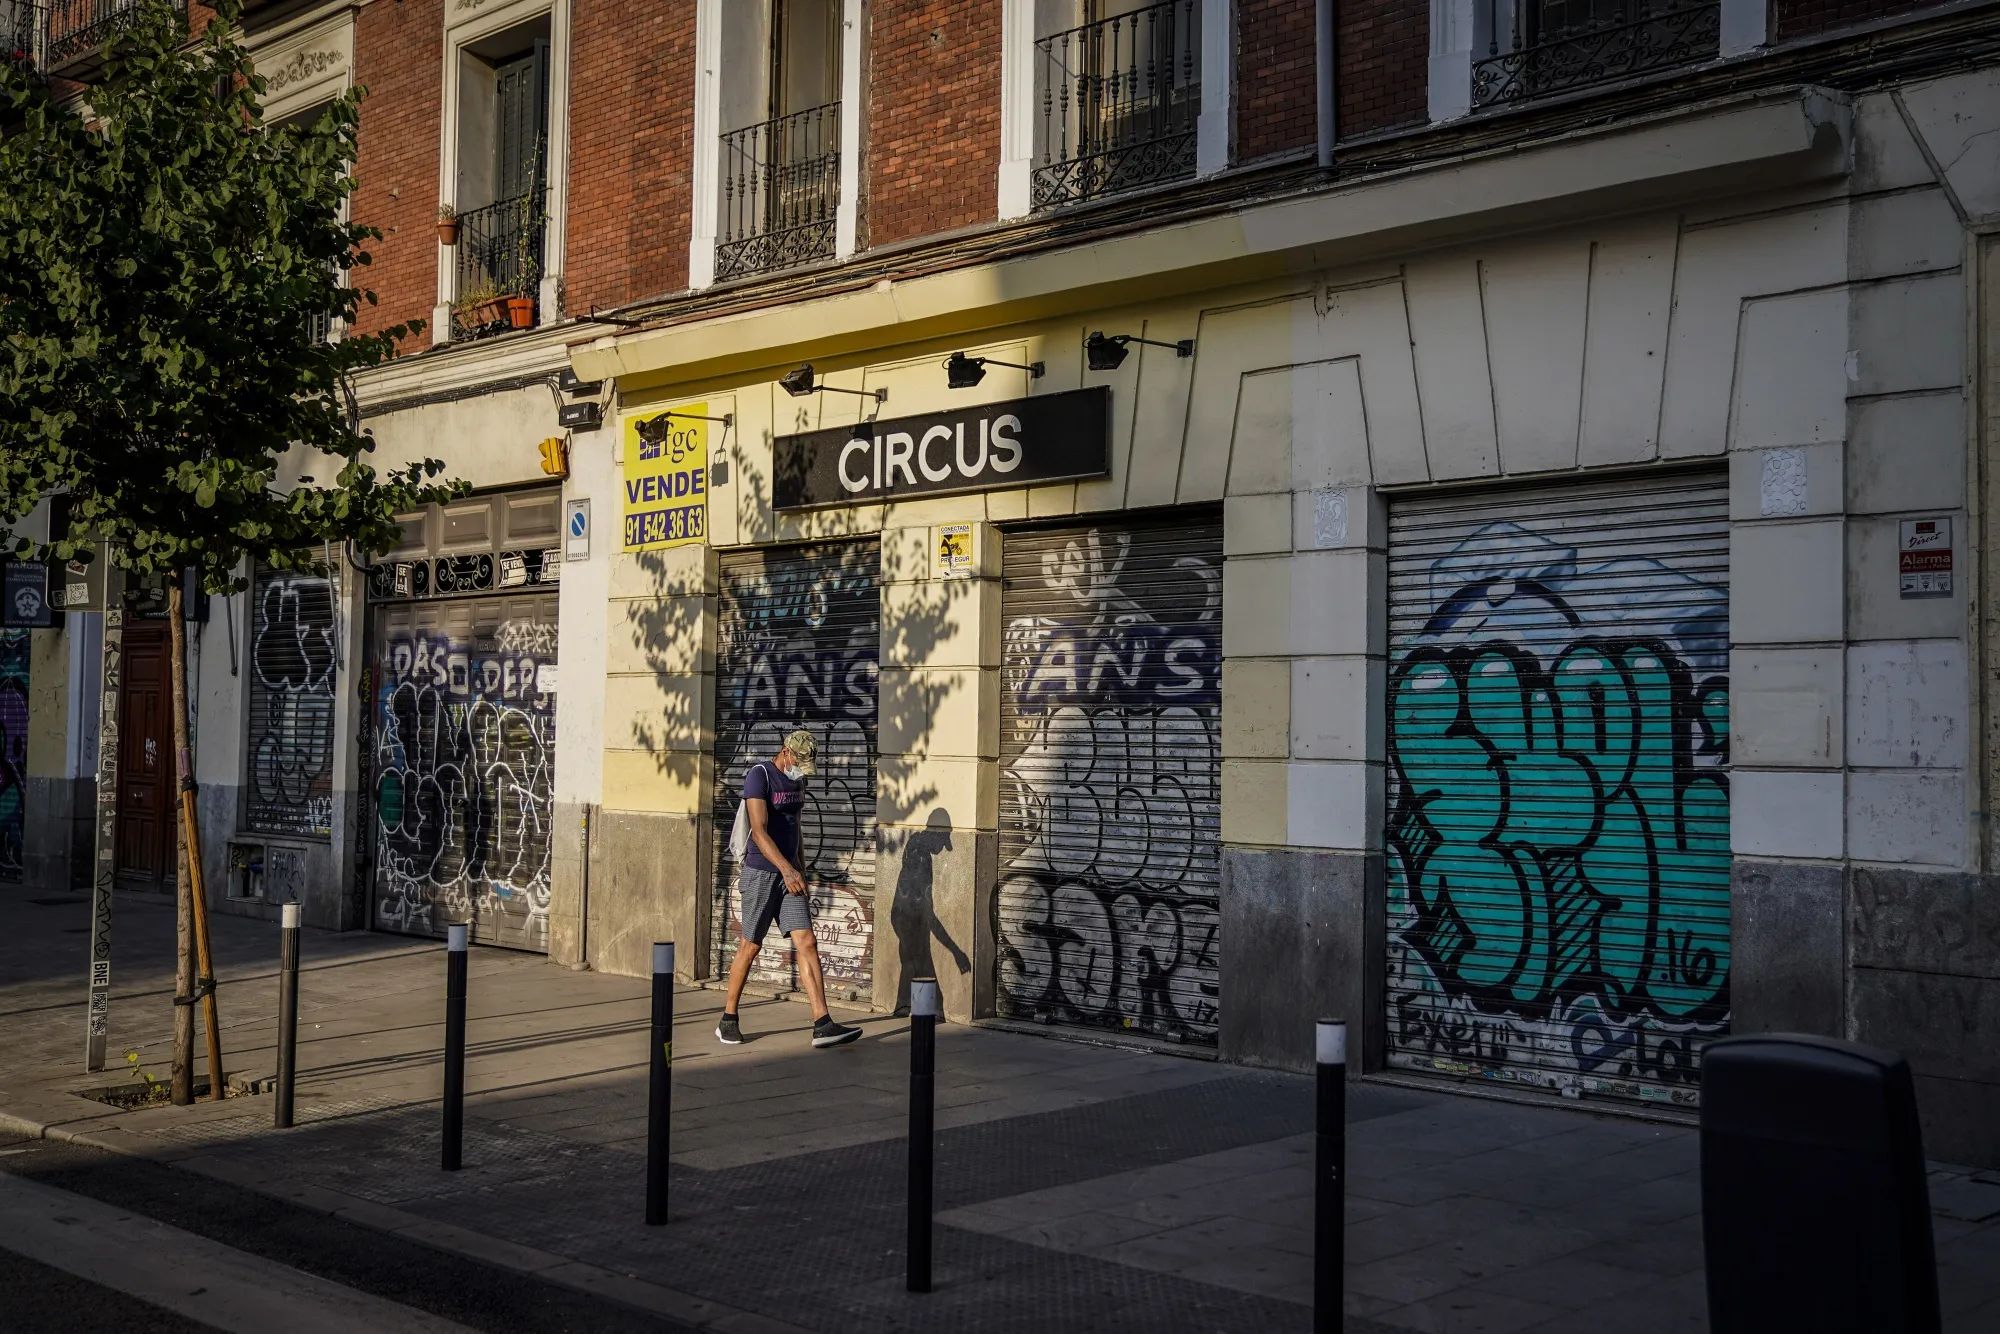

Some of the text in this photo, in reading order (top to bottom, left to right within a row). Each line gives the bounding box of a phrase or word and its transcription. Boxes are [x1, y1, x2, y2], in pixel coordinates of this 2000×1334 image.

[838, 414, 1023, 493] CIRCUS
[626, 468, 705, 504] VENDE
[626, 507, 703, 545] 91 542 36 63
[1901, 554, 1951, 565] Alarma
[94, 963, 107, 984] BNE
